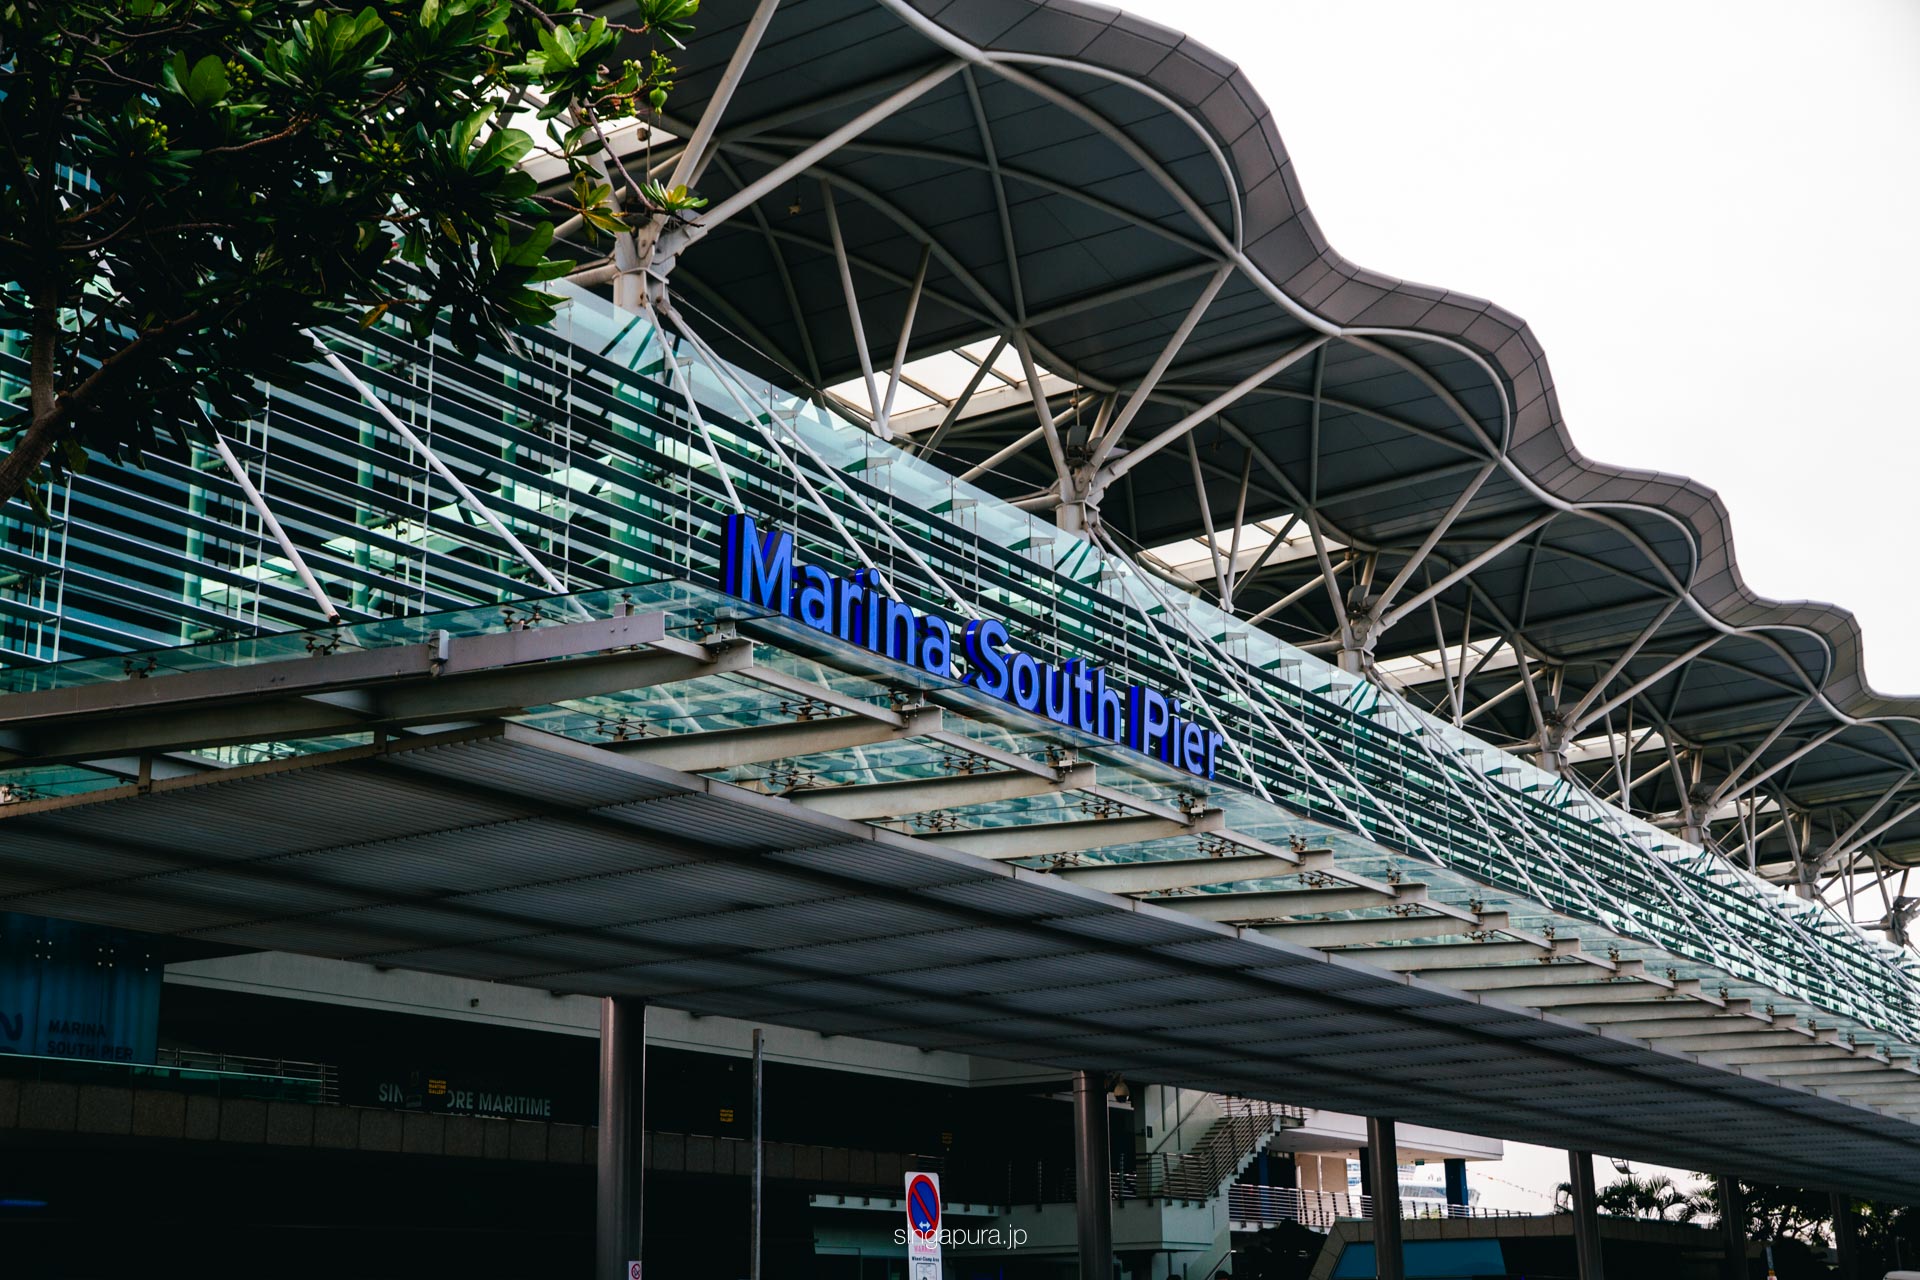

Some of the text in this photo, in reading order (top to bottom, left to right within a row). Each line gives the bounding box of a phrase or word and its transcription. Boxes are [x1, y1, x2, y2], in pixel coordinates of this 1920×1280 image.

[719, 514, 1224, 781] Marina South Pier
[49, 1020, 106, 1038] MARINA
[47, 1040, 134, 1061] SOUTH PIER
[479, 1092, 552, 1117] MARITIME
